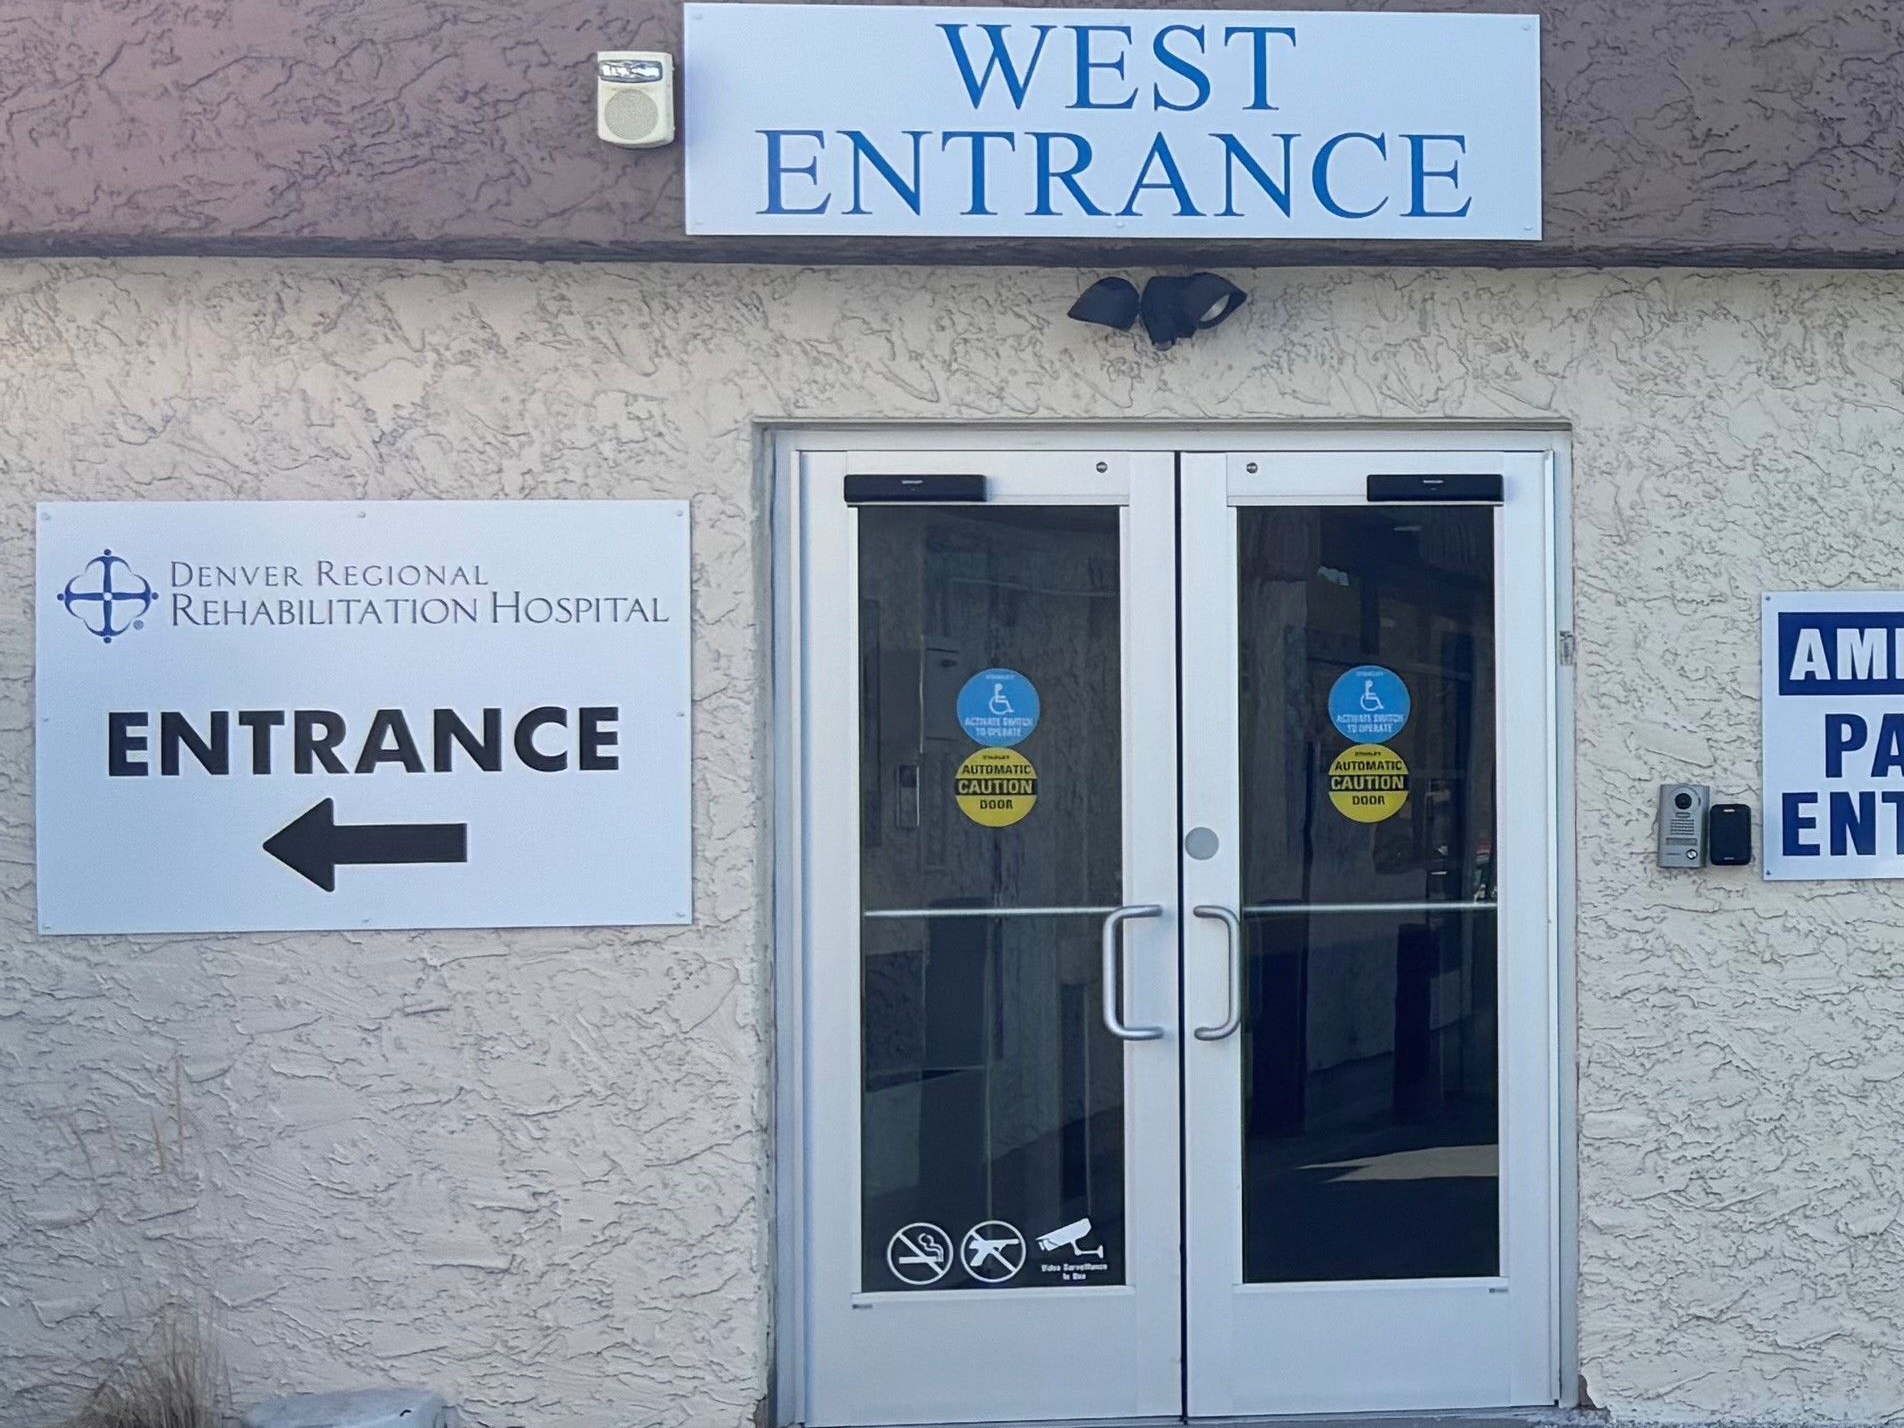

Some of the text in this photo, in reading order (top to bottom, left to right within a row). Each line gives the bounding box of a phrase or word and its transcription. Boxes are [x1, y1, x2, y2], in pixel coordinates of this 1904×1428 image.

[935, 22, 1297, 112] WEST
[753, 129, 1473, 219] ENTRANCE
[171, 560, 489, 588] DENVER REGIONAL
[171, 590, 670, 627] REHABILITATION HOSPITAL
[107, 706, 620, 777] ENTRANCE
[962, 765, 1031, 775] AUTOMATIC
[1335, 761, 1402, 771] AUTOMATIC
[958, 780, 1032, 794] CAUTION
[1331, 776, 1404, 790] CAUTION
[980, 800, 1013, 810] DOOR
[1352, 795, 1385, 805] DOOR
